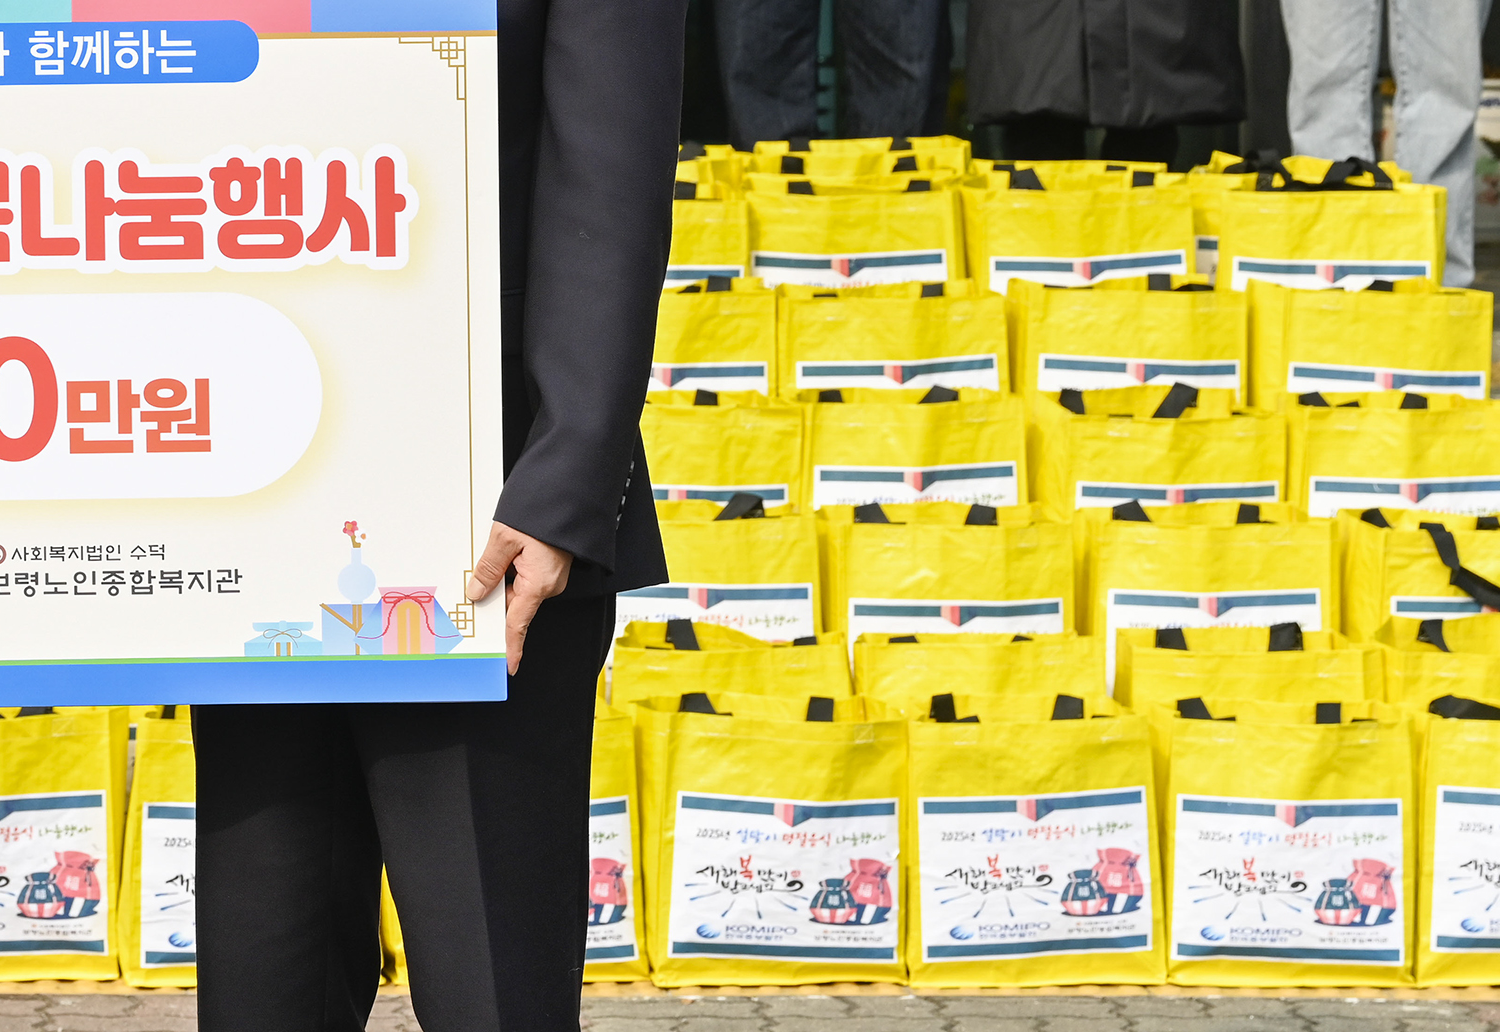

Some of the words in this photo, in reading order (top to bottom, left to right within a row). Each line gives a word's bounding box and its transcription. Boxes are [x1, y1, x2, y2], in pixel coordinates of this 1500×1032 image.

[29, 30, 196, 75] 함께하는
[11, 544, 121, 562] 사회복지법인
[130, 544, 165, 561] 수덕
[38, 824, 93, 840] 나눔행사
[696, 865, 737, 883] 새해
[740, 855, 752, 880] 복
[758, 869, 787, 882] 많이
[725, 924, 797, 935] KOMIPO
[979, 921, 1050, 931] KOMIPO
[1230, 927, 1302, 937] KOMIPO
